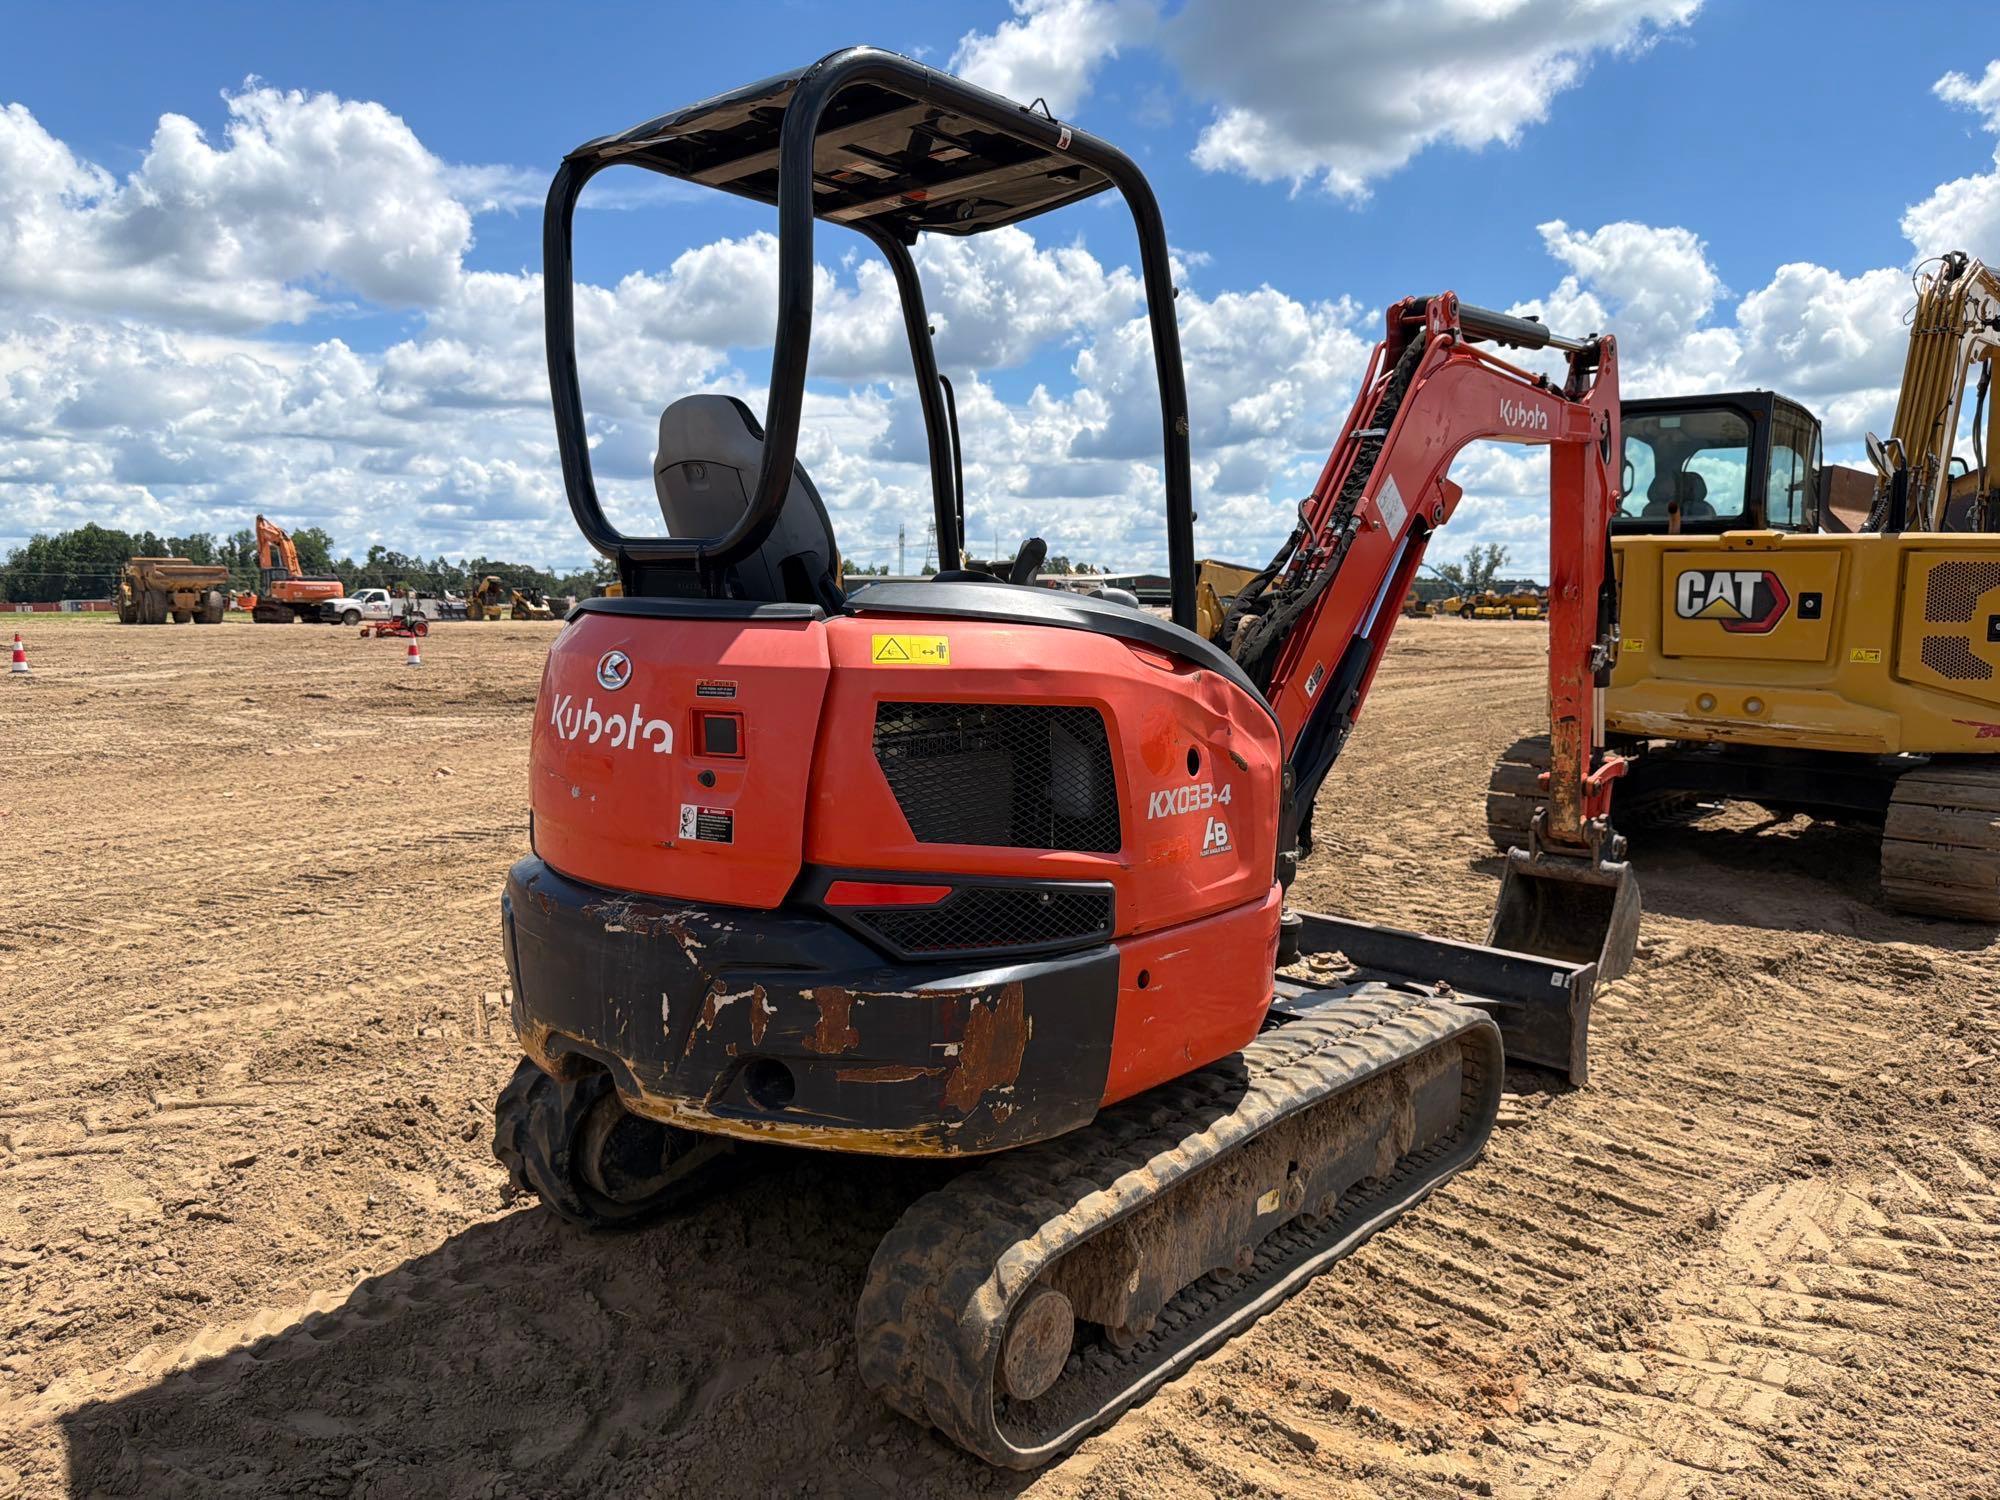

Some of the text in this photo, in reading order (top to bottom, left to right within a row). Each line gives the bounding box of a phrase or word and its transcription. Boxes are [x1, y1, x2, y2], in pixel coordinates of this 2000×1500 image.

[1500, 398, 1548, 430] Kubota
[1677, 570, 1763, 619] CAT
[551, 693, 674, 754] Kubota
[1147, 783, 1232, 820] KX033-4
[1202, 816, 1229, 850] AB
